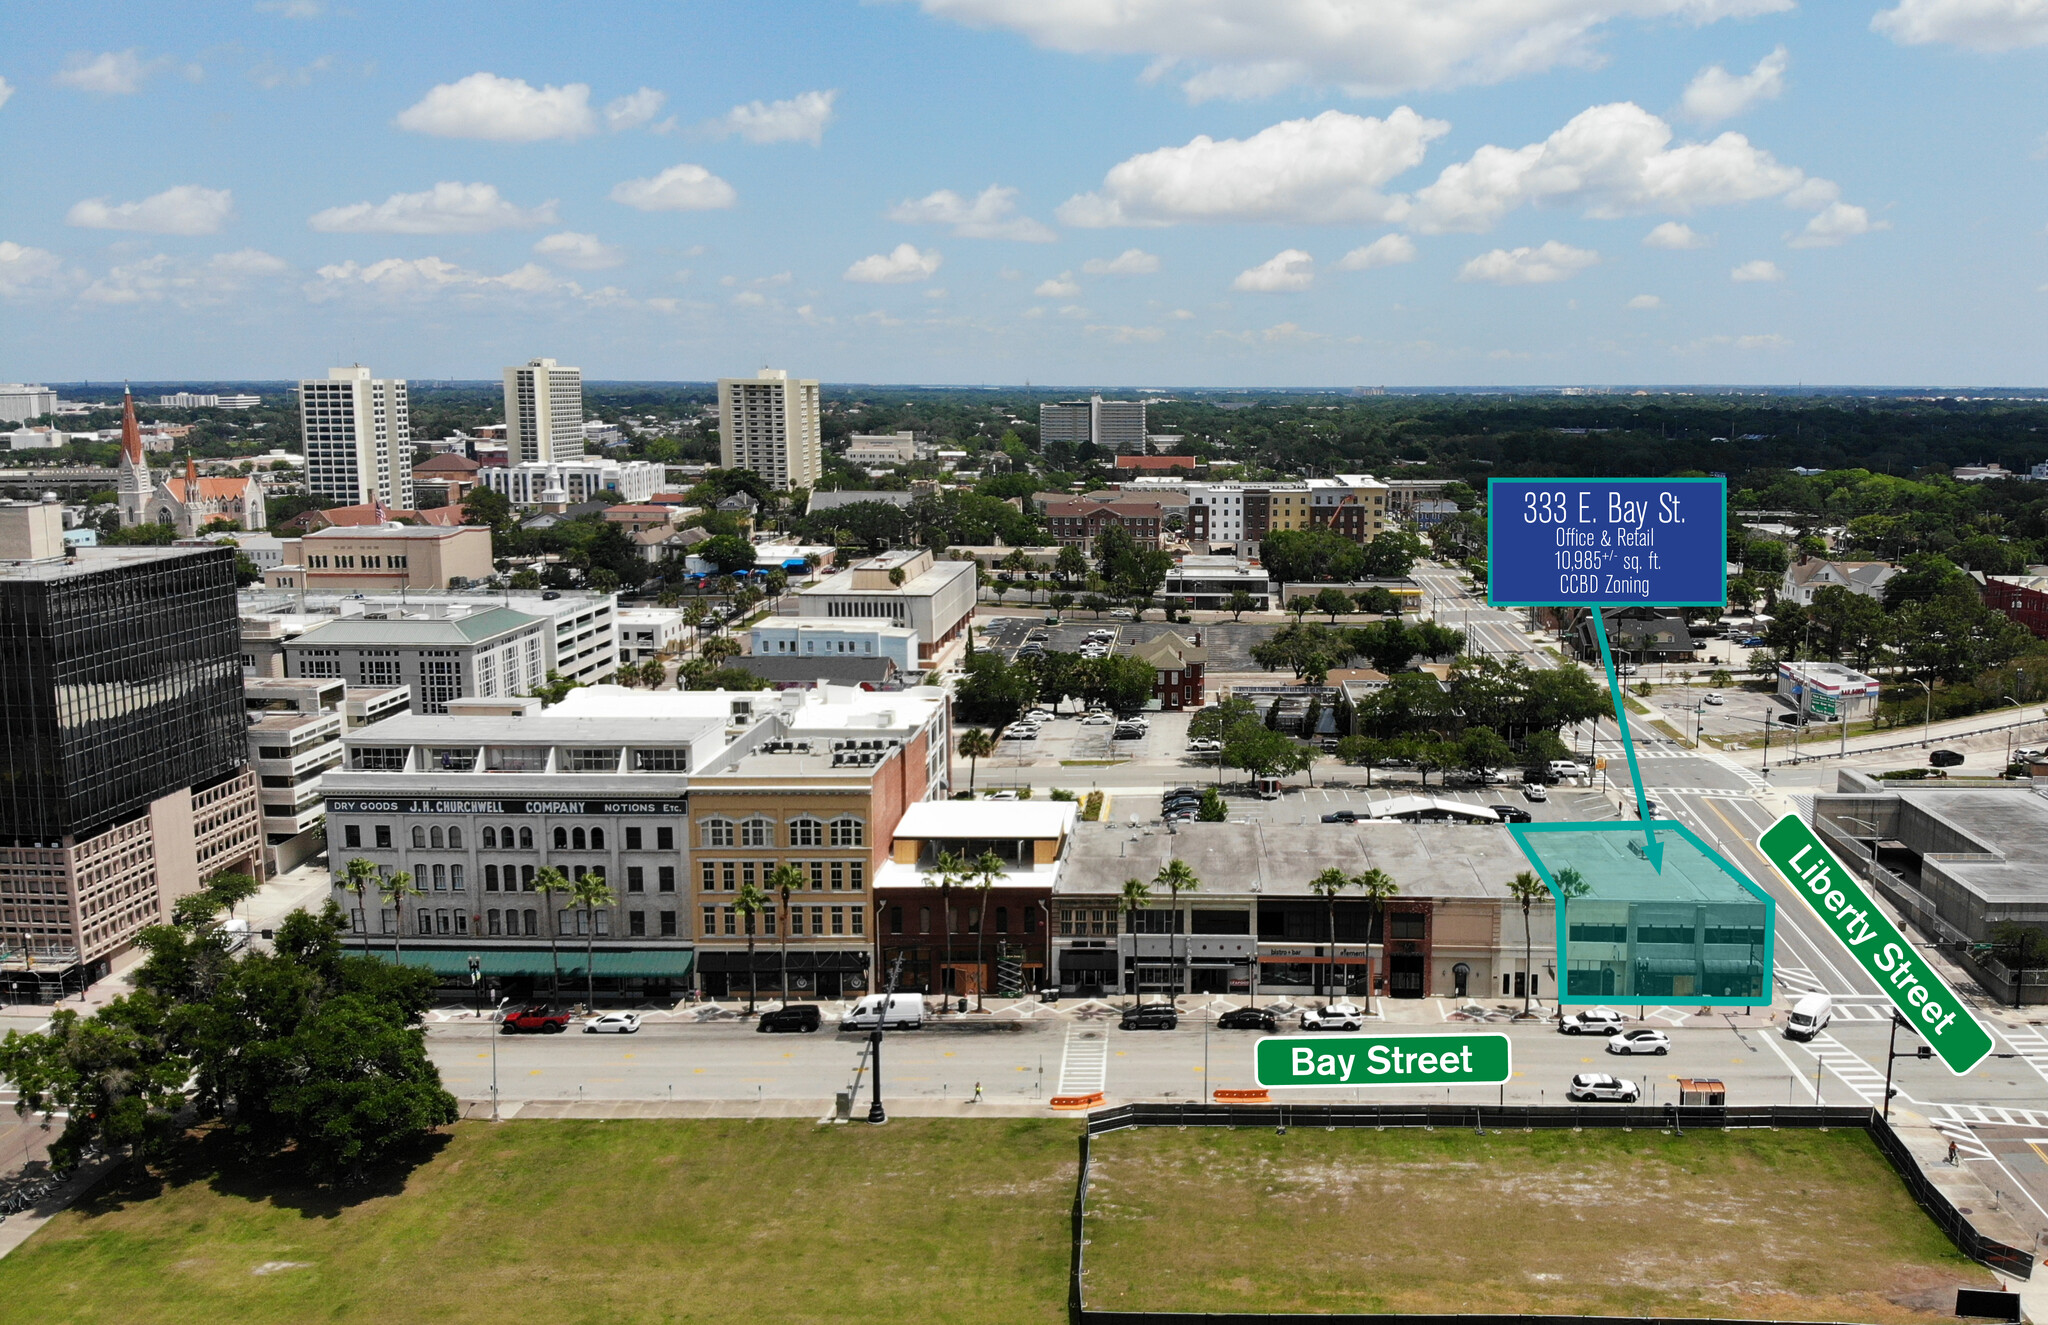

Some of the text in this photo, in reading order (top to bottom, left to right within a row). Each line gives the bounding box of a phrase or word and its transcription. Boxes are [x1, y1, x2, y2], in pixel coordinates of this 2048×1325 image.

[334, 802, 355, 810] DRY
[359, 802, 399, 811] GOODS
[435, 801, 505, 813] CHURCHWELL
[525, 802, 585, 814] COMPANY
[604, 804, 656, 812] NOTIONS
